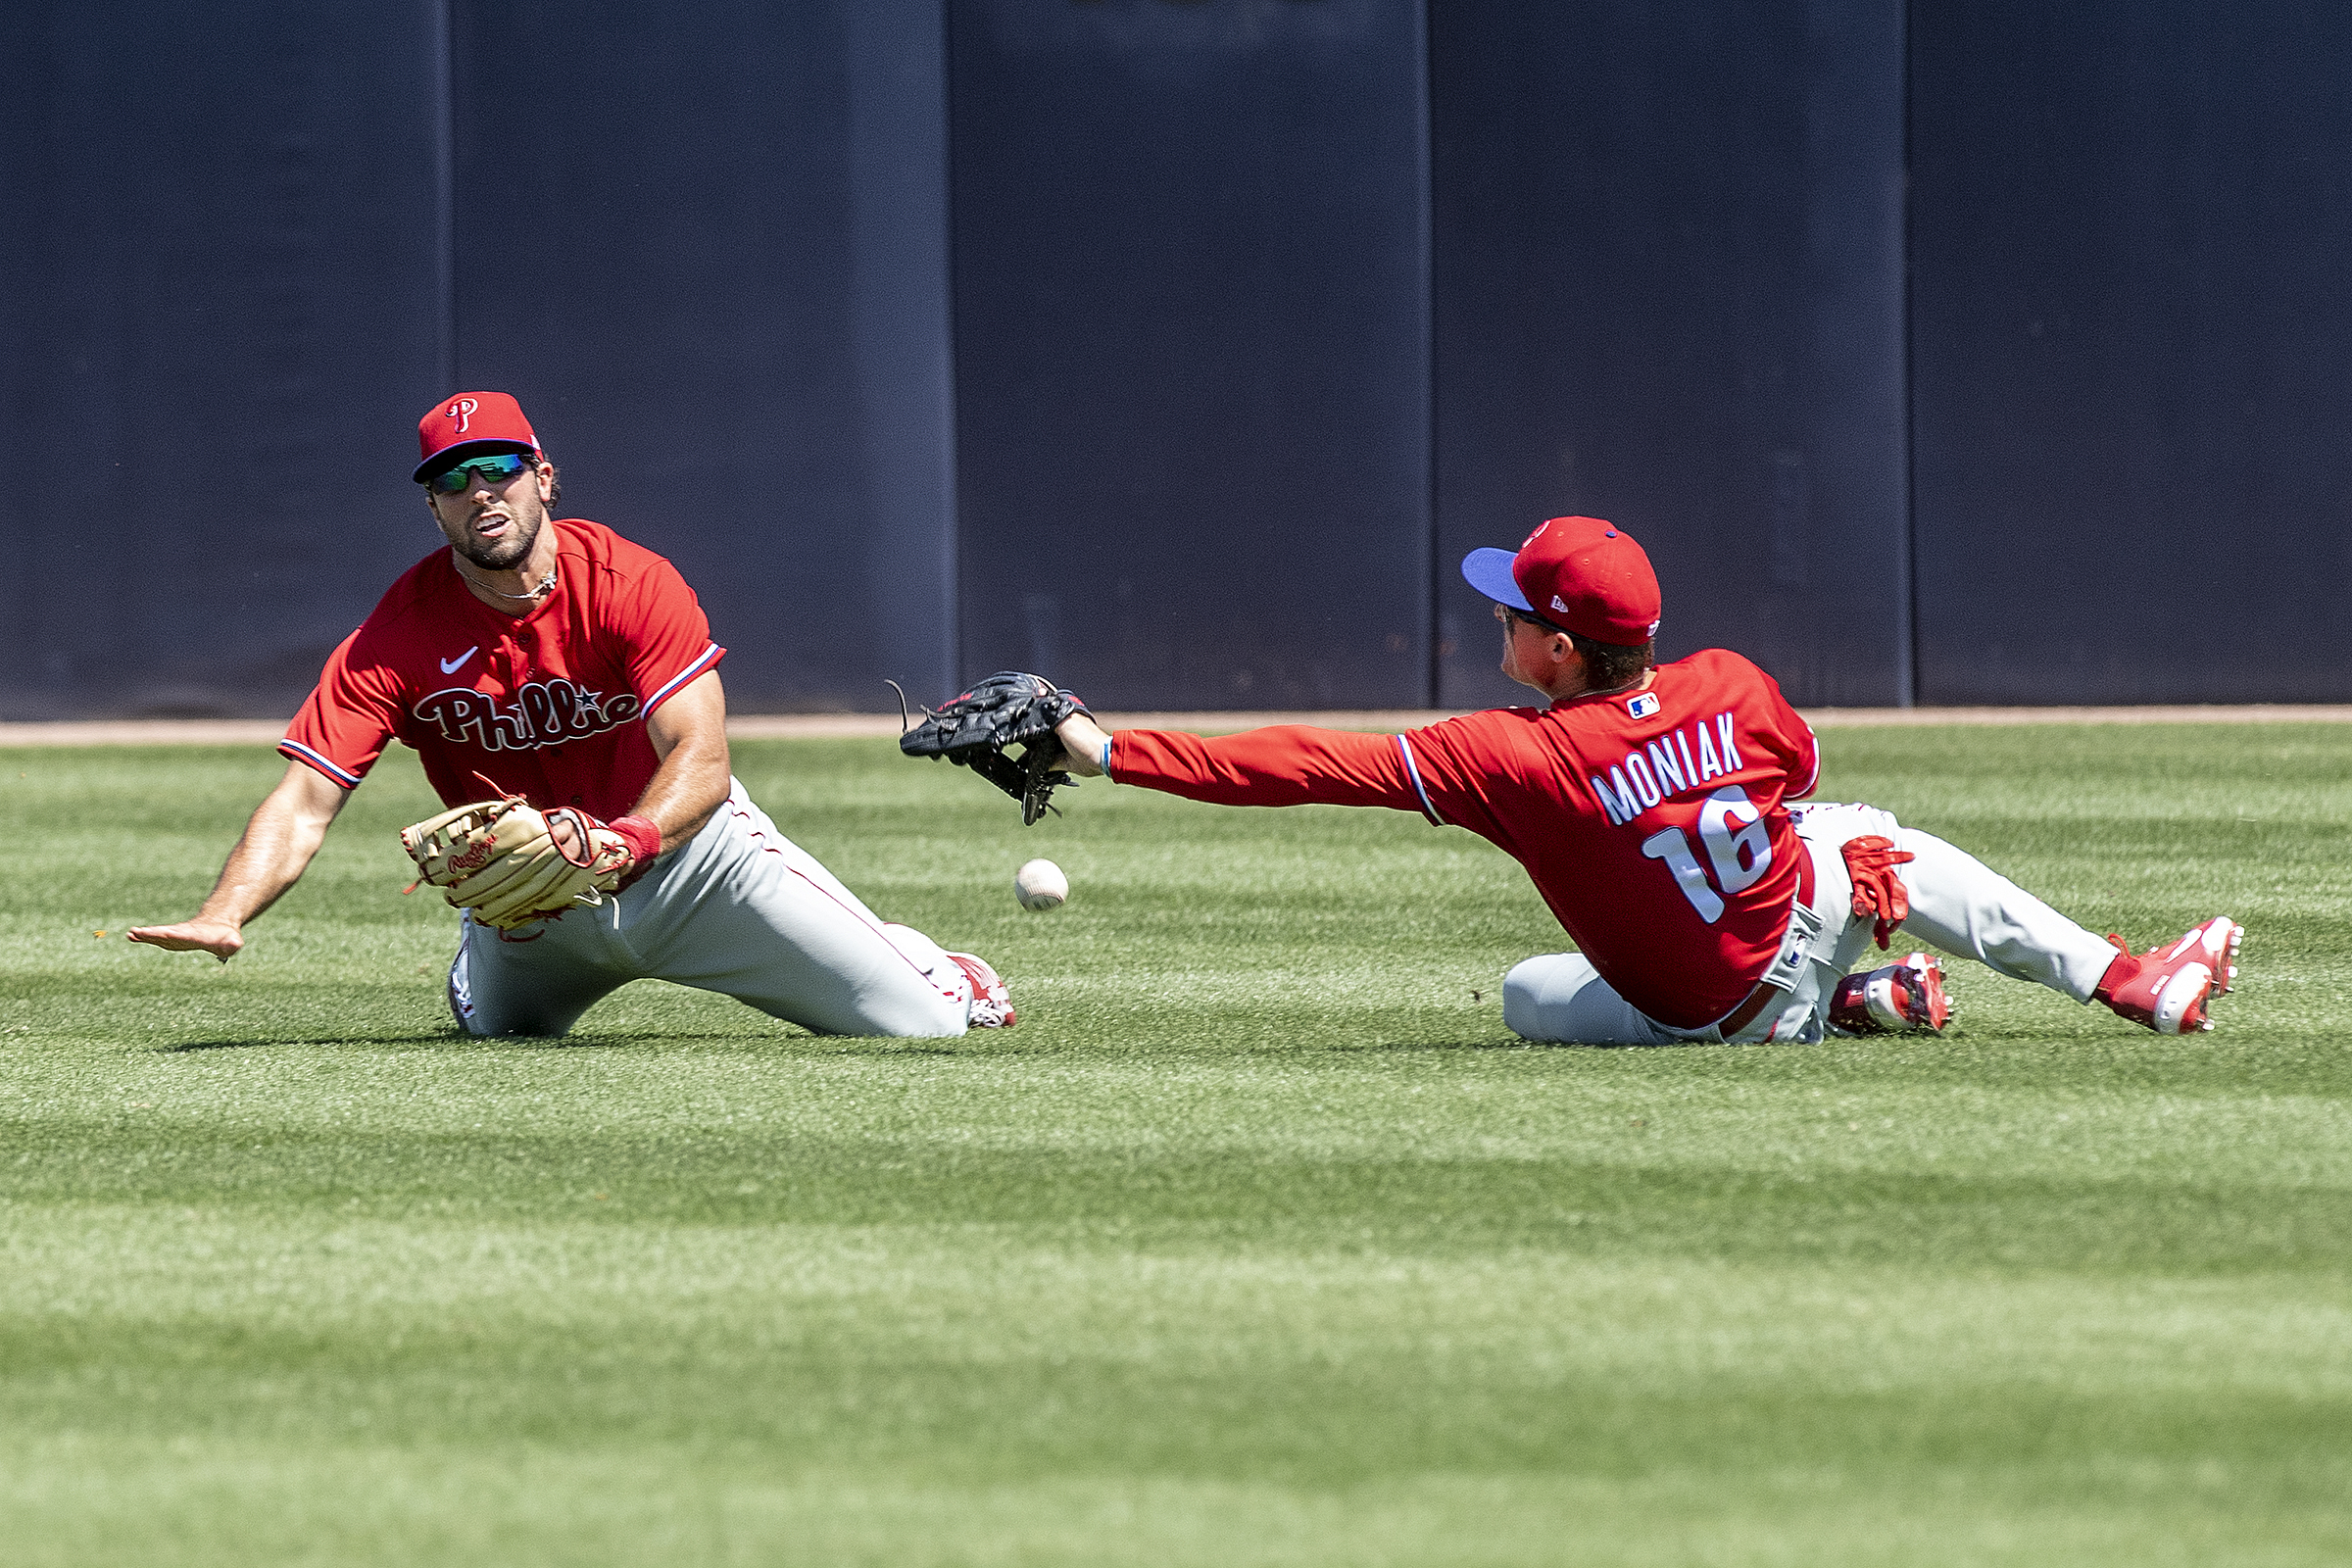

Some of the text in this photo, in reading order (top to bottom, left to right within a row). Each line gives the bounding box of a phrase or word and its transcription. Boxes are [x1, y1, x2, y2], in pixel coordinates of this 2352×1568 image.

[446, 398, 479, 433] P
[413, 678, 640, 751] Phillie
[1591, 711, 1742, 825] MONIAK
[1642, 785, 1773, 924] 16
